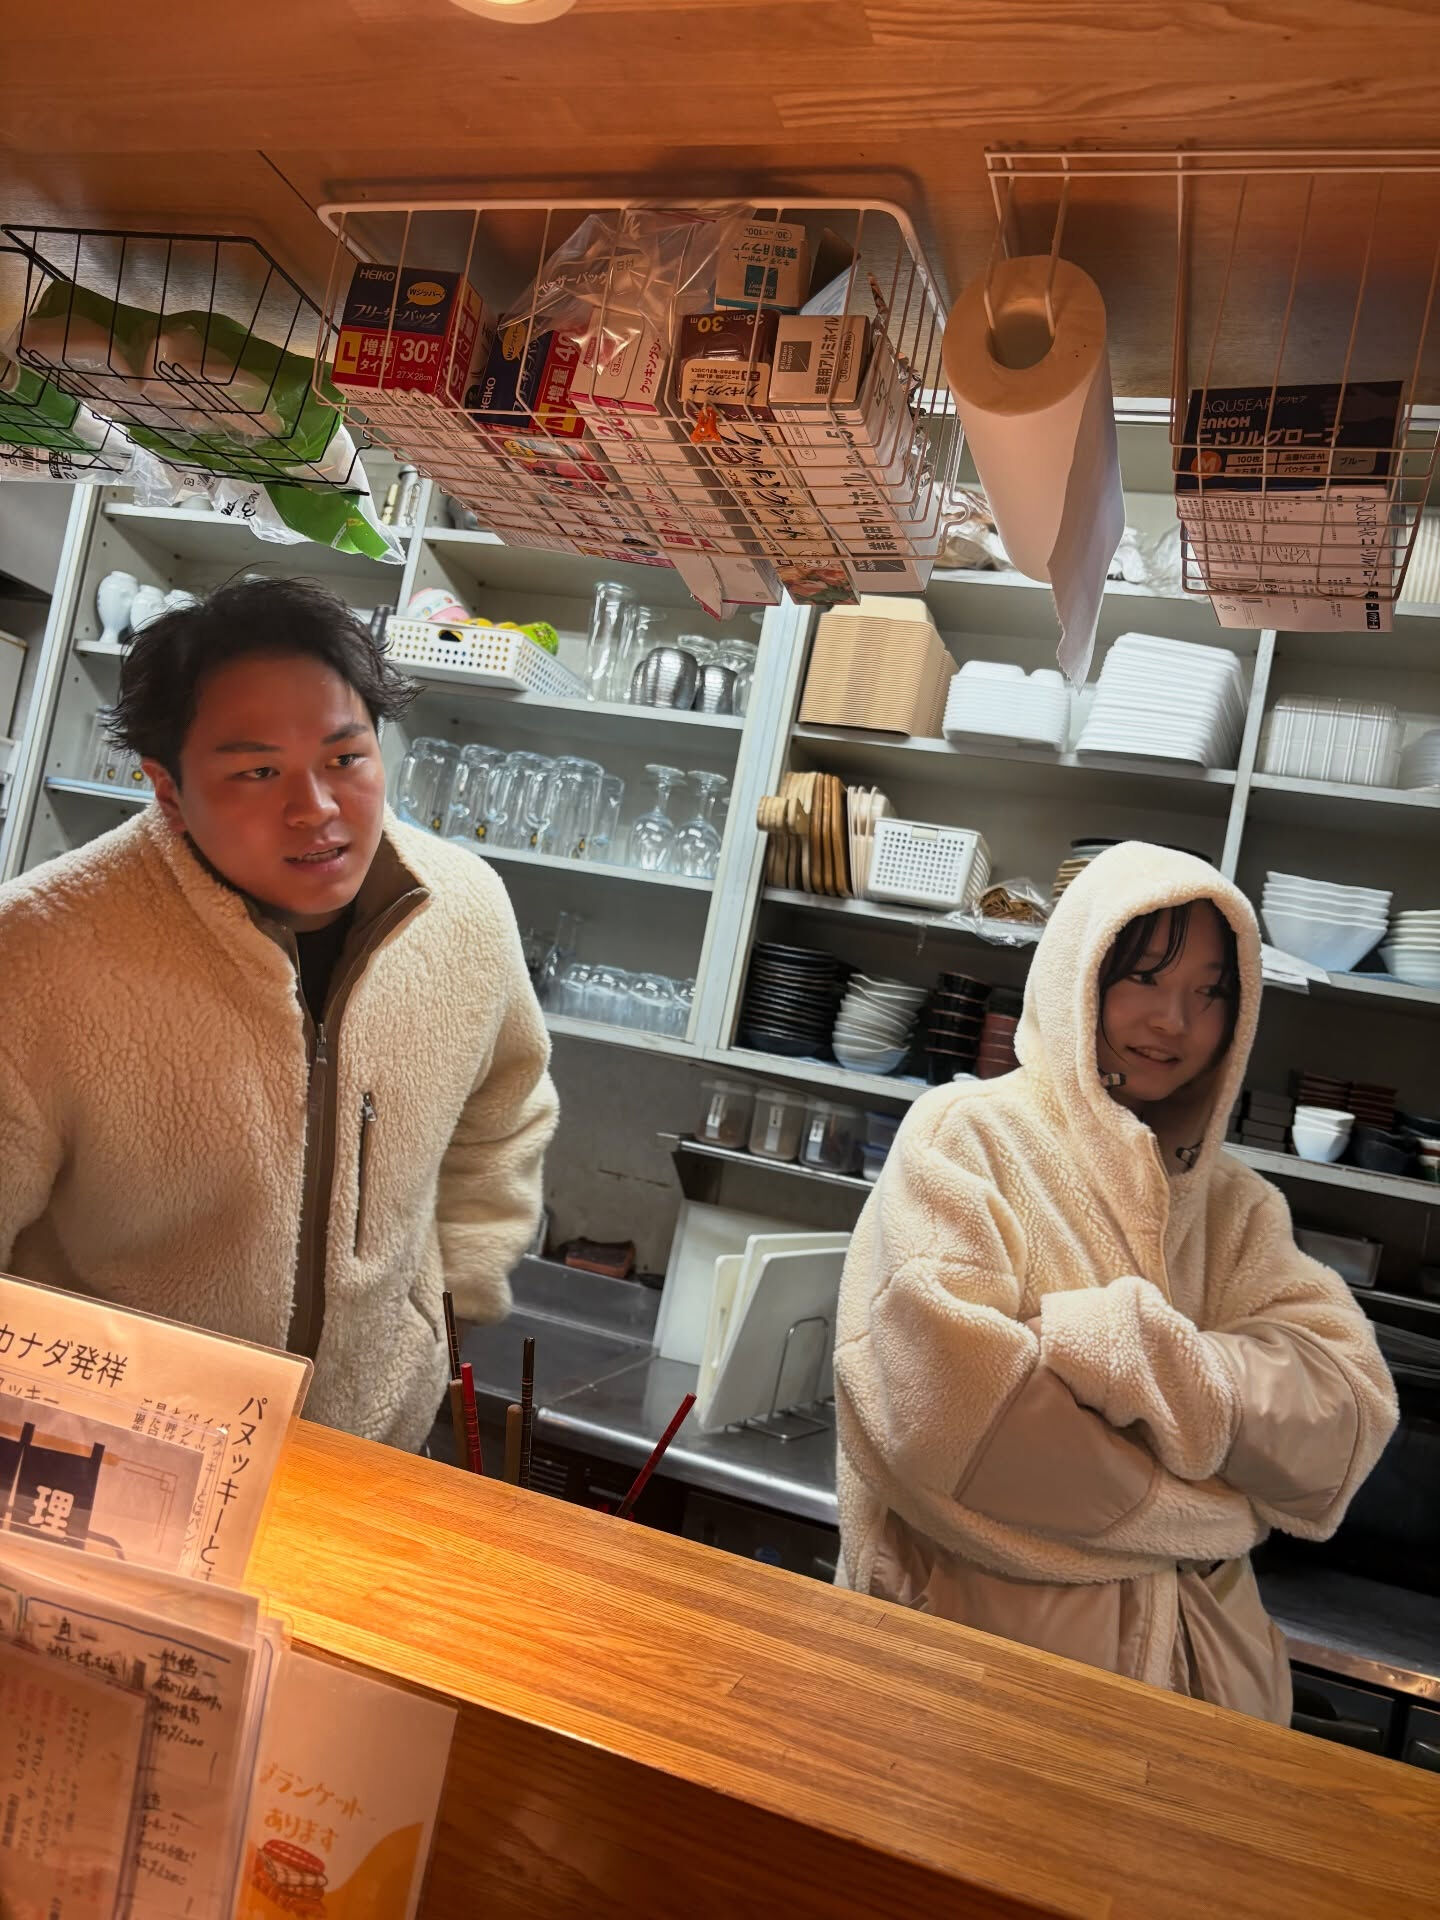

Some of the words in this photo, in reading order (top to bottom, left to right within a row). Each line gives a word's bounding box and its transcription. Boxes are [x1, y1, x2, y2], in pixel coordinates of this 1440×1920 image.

[360, 268, 396, 282] HEIKO
[352, 304, 441, 324] フリーザーバッグ
[342, 341, 356, 362] L
[362, 338, 395, 358] 増量
[815, 317, 840, 395] 業務用アルミホイル
[480, 376, 497, 410] HEIKO
[1199, 425, 1345, 446] ニトリルグローブ
[0, 1323, 128, 1388] カナダ発祥
[28, 1485, 75, 1538] 理
[264, 1807, 339, 1854] あります
